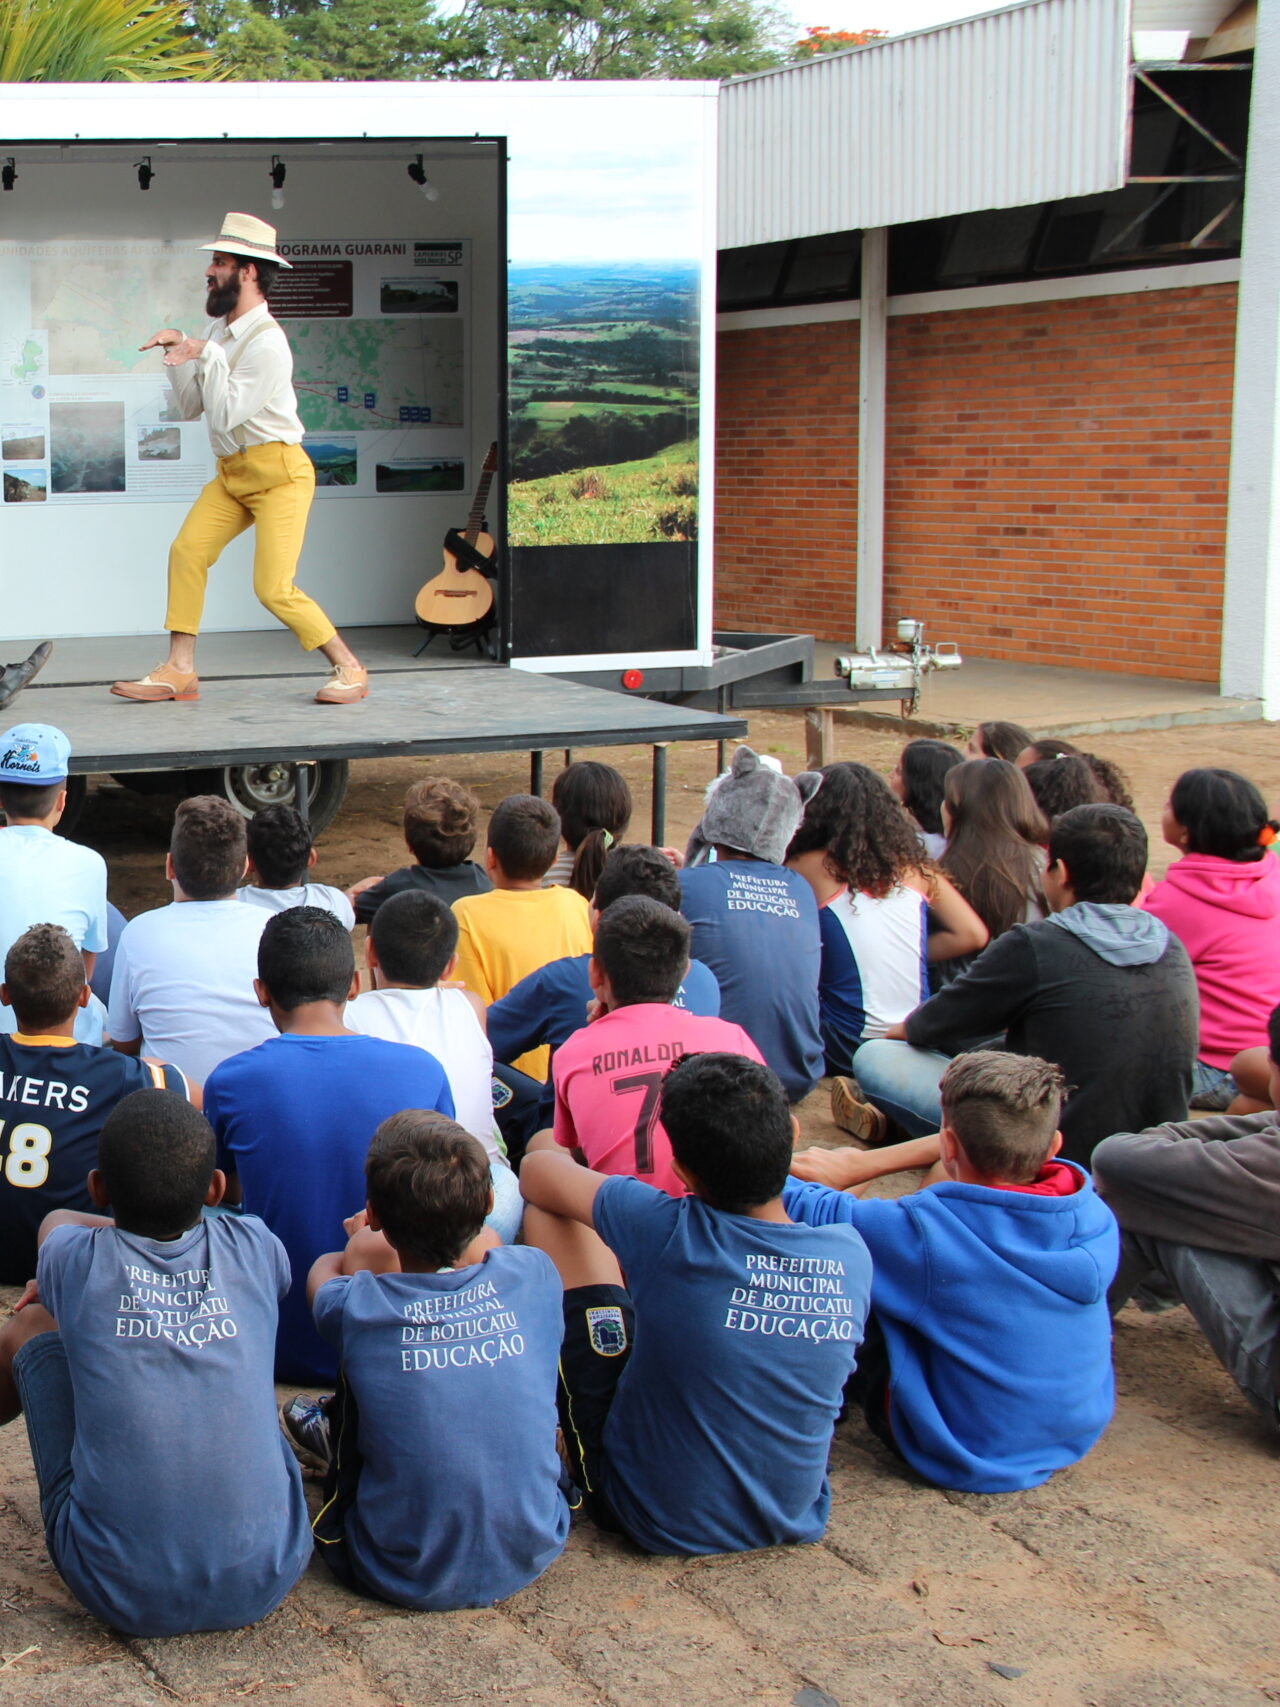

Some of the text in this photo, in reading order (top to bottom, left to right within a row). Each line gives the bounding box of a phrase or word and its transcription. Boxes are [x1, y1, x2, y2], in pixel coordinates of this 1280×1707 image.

[345, 243, 406, 256] GUARANI
[447, 250, 463, 265] SP
[0, 749, 41, 773] Hornets
[727, 889, 742, 899] DE
[732, 881, 788, 897] MUNICIPAL
[727, 900, 800, 919] EDUCAÇÃO
[592, 1042, 684, 1076] RONALDO
[610, 1068, 663, 1174] 7
[125, 1264, 213, 1288] REFEITUR
[745, 1254, 846, 1276] PREFEITURA
[130, 1281, 216, 1306] UNICIPL
[749, 1272, 844, 1294] MUNICIPAL
[120, 1295, 228, 1326] DE OTUCATU
[403, 1280, 498, 1318] PREFEITURA
[731, 1287, 852, 1314] DE BOTUCATU
[402, 1311, 518, 1342] DE BOTUCATU
[724, 1308, 853, 1344] EDUCAÇÃO
[401, 1333, 524, 1371] EDUCAÇÃO
